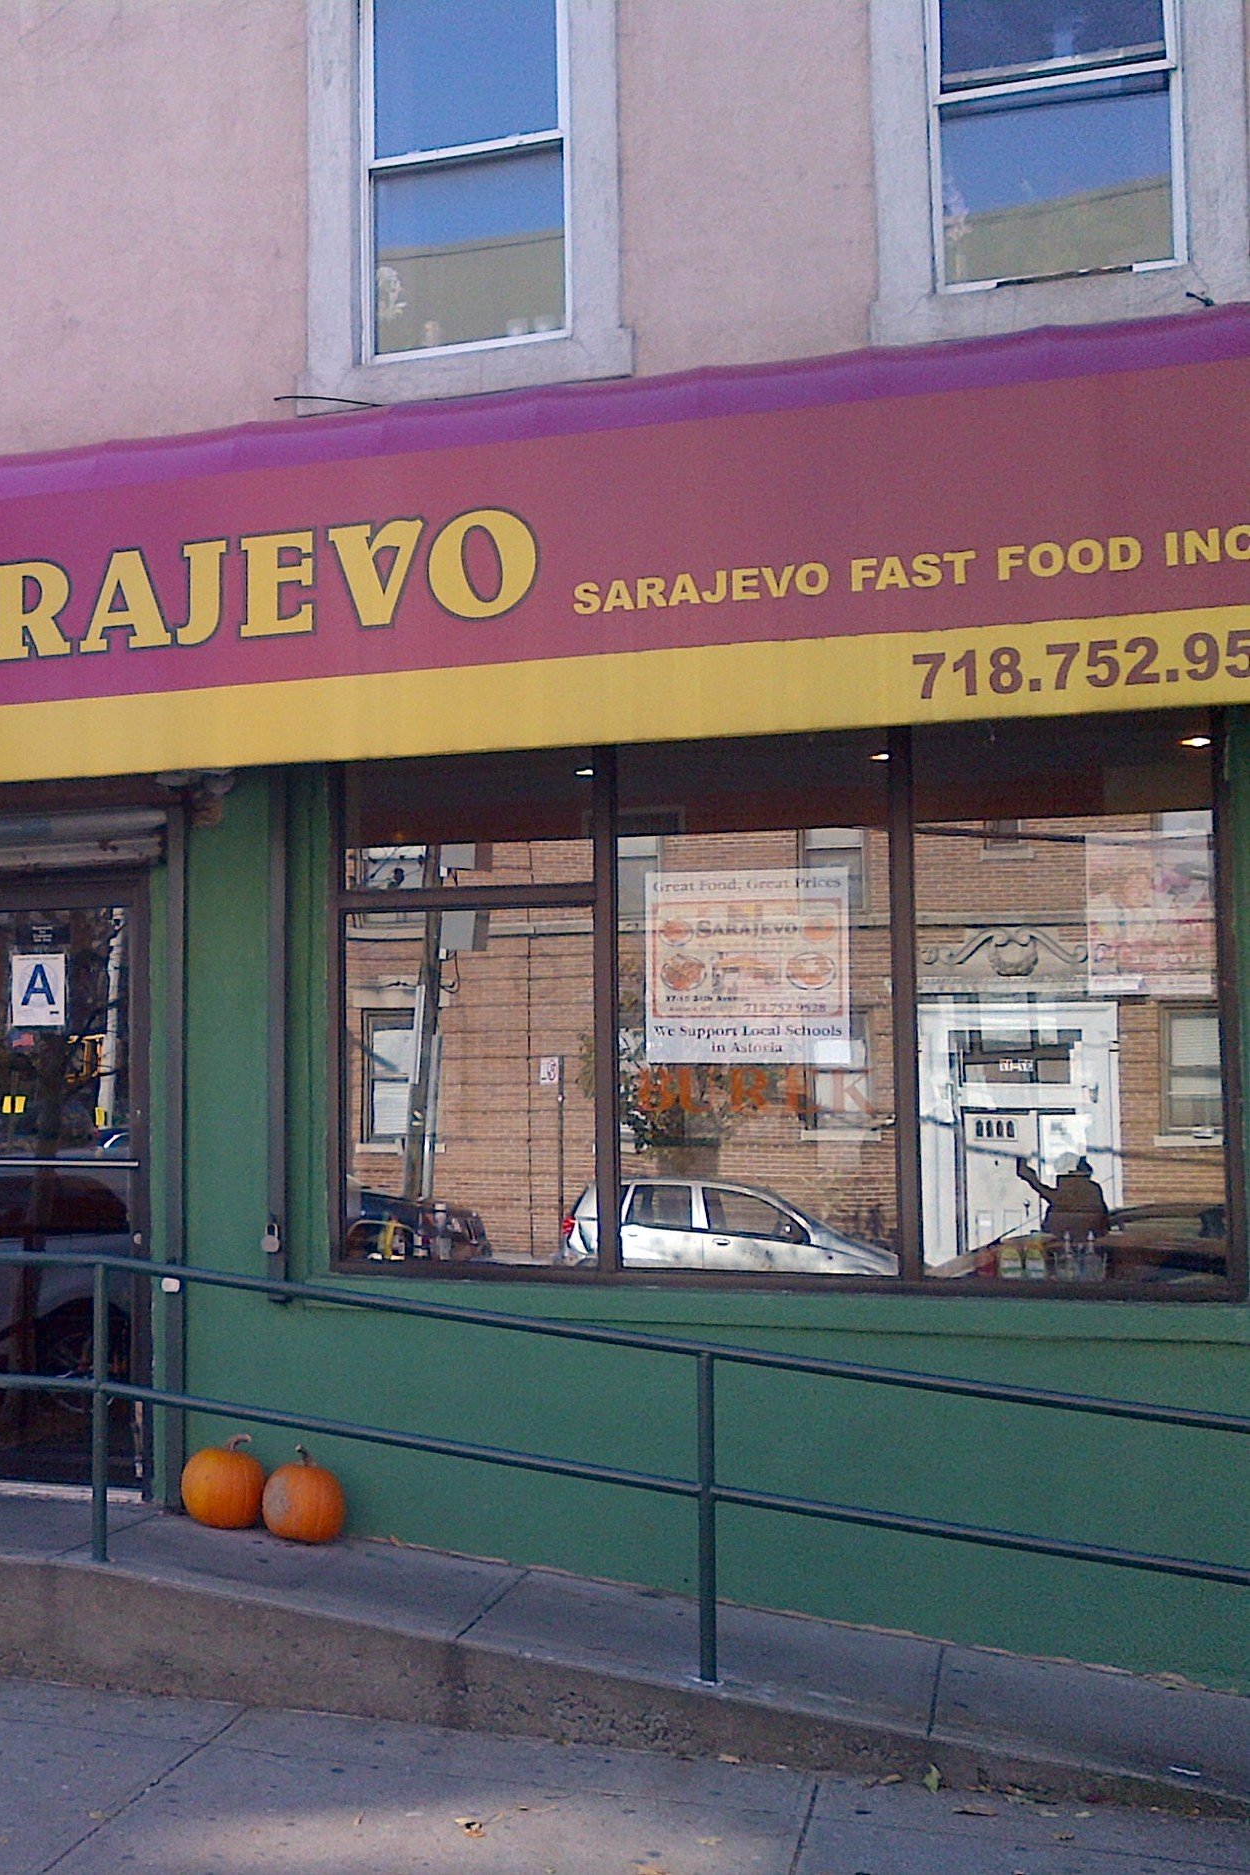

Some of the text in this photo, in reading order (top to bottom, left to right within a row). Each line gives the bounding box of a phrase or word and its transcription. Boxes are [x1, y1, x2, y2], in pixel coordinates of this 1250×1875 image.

[573, 562, 830, 615] SARAJEVO
[850, 551, 976, 592] FAST
[997, 535, 1143, 581] FOOD
[653, 878, 695, 893] Great
[746, 877, 791, 891] Great
[795, 876, 842, 889] Prices
[21, 963, 56, 1006] A
[654, 1023, 842, 1040] We Support Local Schools
[711, 1041, 783, 1054] in Astoria
[637, 1066, 875, 1115] BUREK
